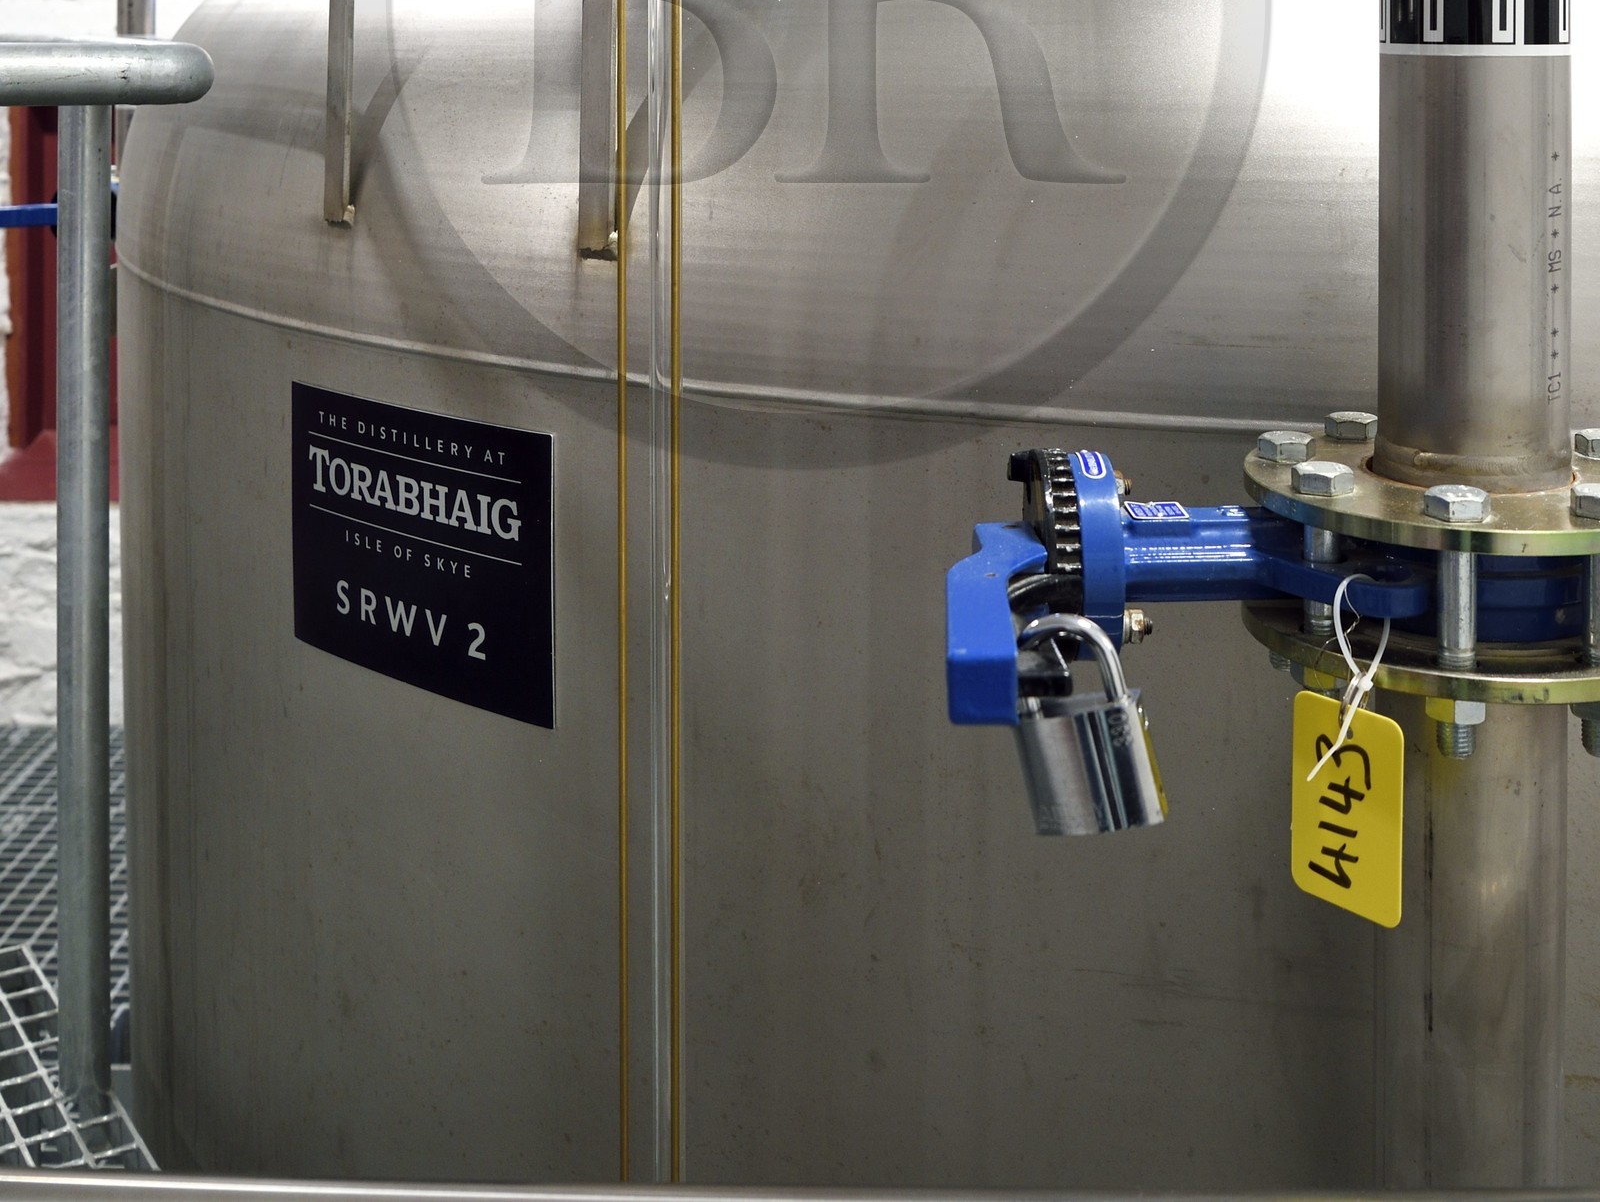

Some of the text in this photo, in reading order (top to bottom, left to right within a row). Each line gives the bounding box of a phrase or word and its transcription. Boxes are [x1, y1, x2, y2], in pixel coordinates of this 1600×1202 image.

[1547, 249, 1562, 273] MS
[318, 410, 505, 466] THE DISTILLERY AT
[308, 444, 522, 542] TORABHAIG
[345, 529, 472, 579] ISLE OF SKYE
[336, 579, 487, 661] SRWV 2
[1307, 733, 1372, 890] 4143
